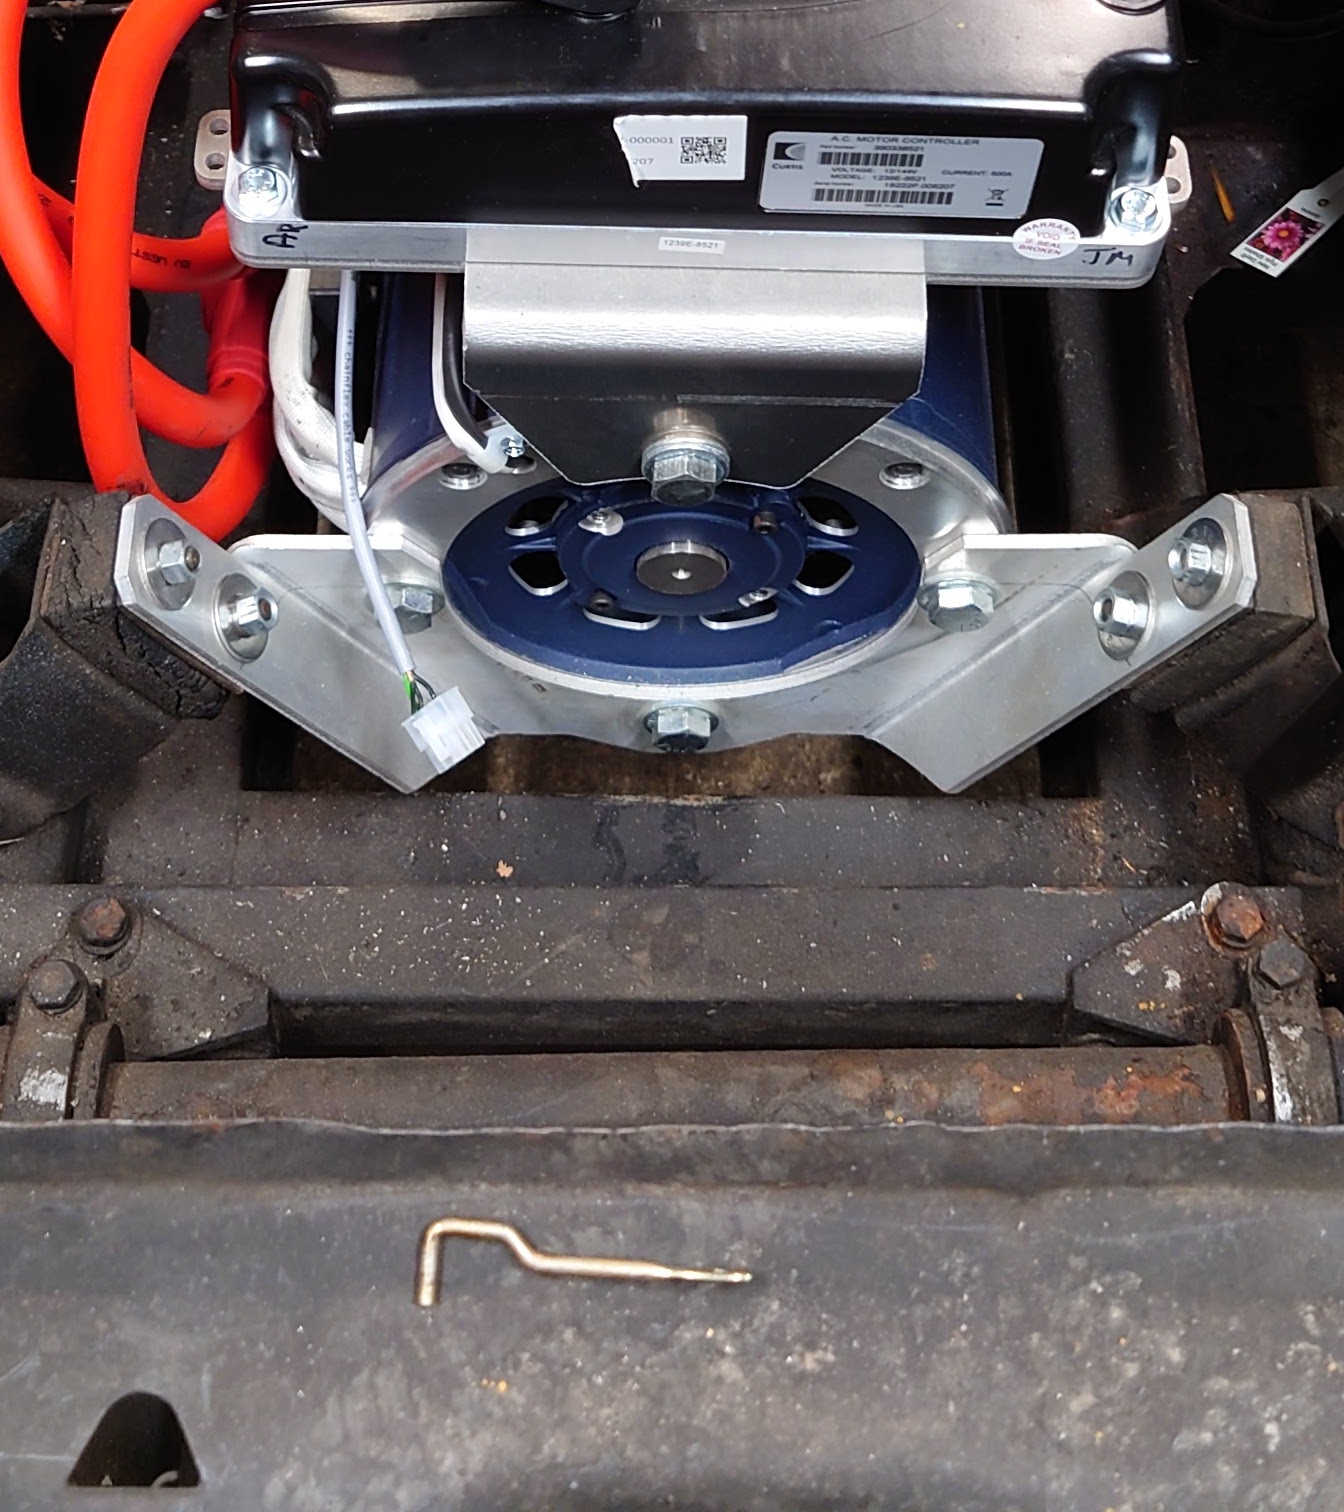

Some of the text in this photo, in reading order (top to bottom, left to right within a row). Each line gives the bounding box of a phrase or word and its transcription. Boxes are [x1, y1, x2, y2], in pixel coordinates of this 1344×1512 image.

[857, 136, 899, 144] MOTOR
[902, 137, 980, 146] CONTROLLER
[1021, 221, 1076, 240] WARRANTY
[1036, 231, 1060, 240] VOID
[663, 239, 719, 249] 1239E-8521
[1036, 240, 1062, 249] SEAL
[1018, 244, 1062, 256] BROKEN
[342, 352, 353, 409] chainflex
